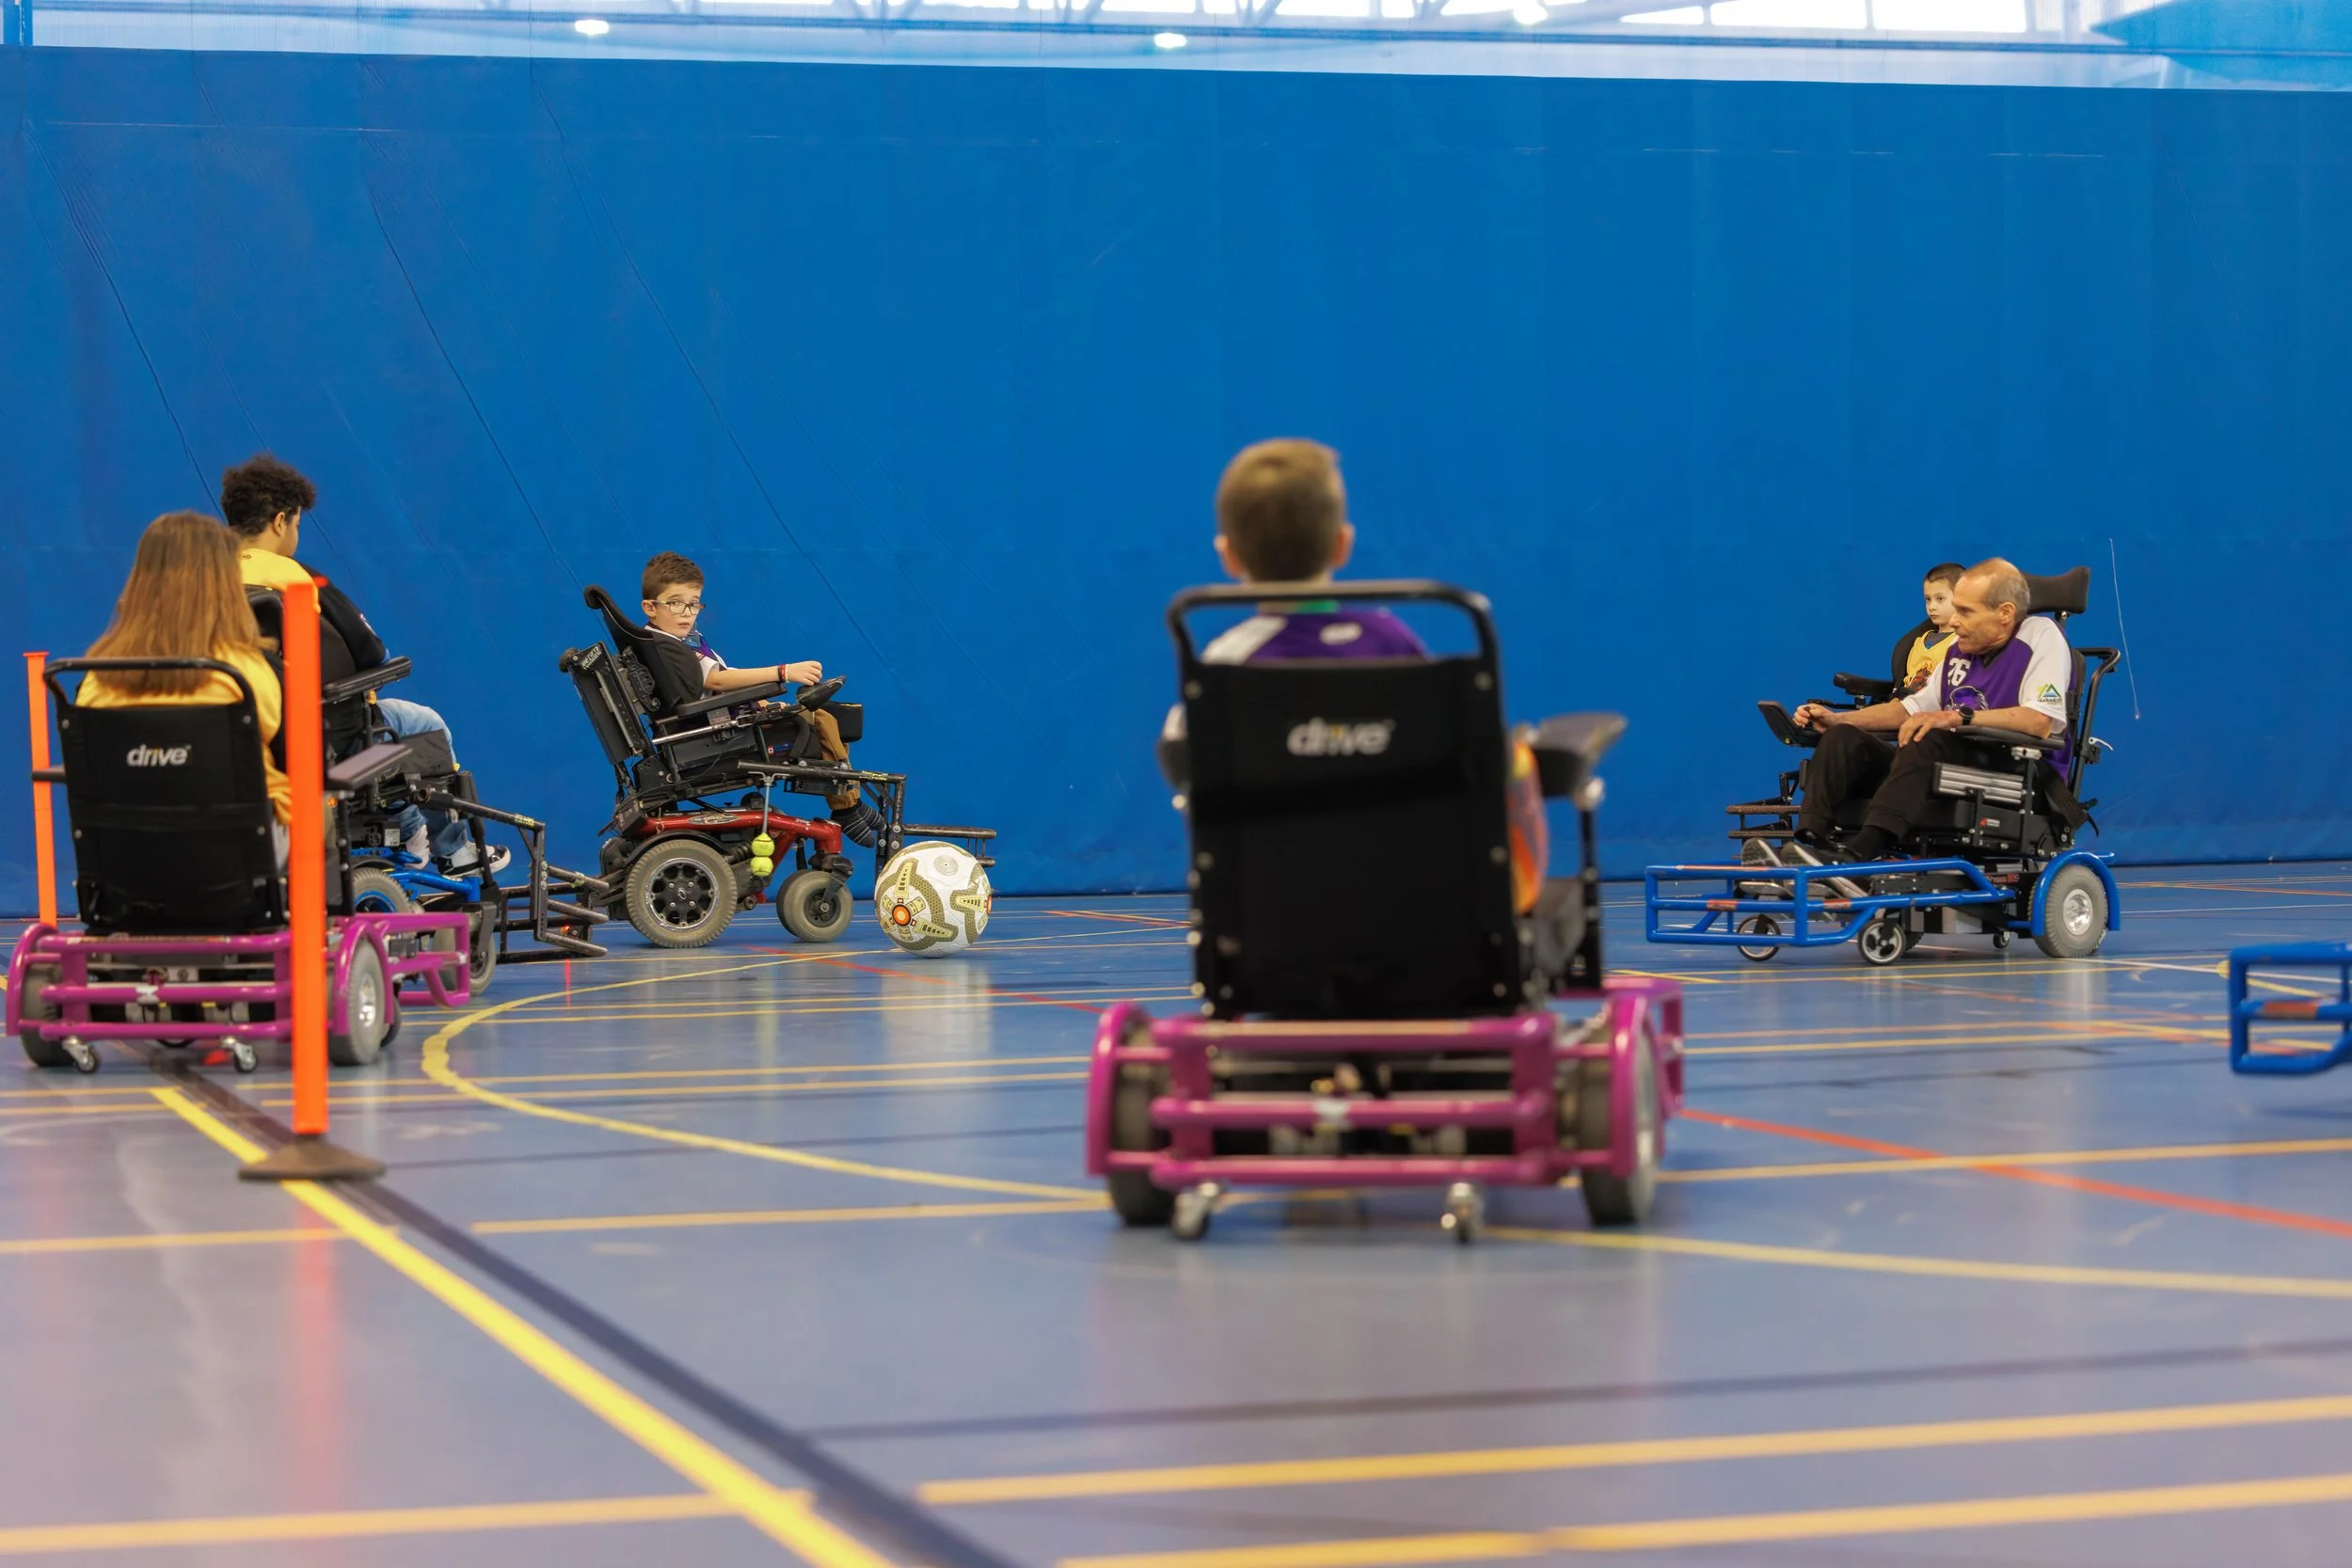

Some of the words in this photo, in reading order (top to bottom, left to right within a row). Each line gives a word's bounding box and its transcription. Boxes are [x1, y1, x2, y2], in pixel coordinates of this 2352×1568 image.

[1947, 657, 1971, 687] 26
[1287, 716, 1391, 757] drive
[126, 743, 189, 767] drive
